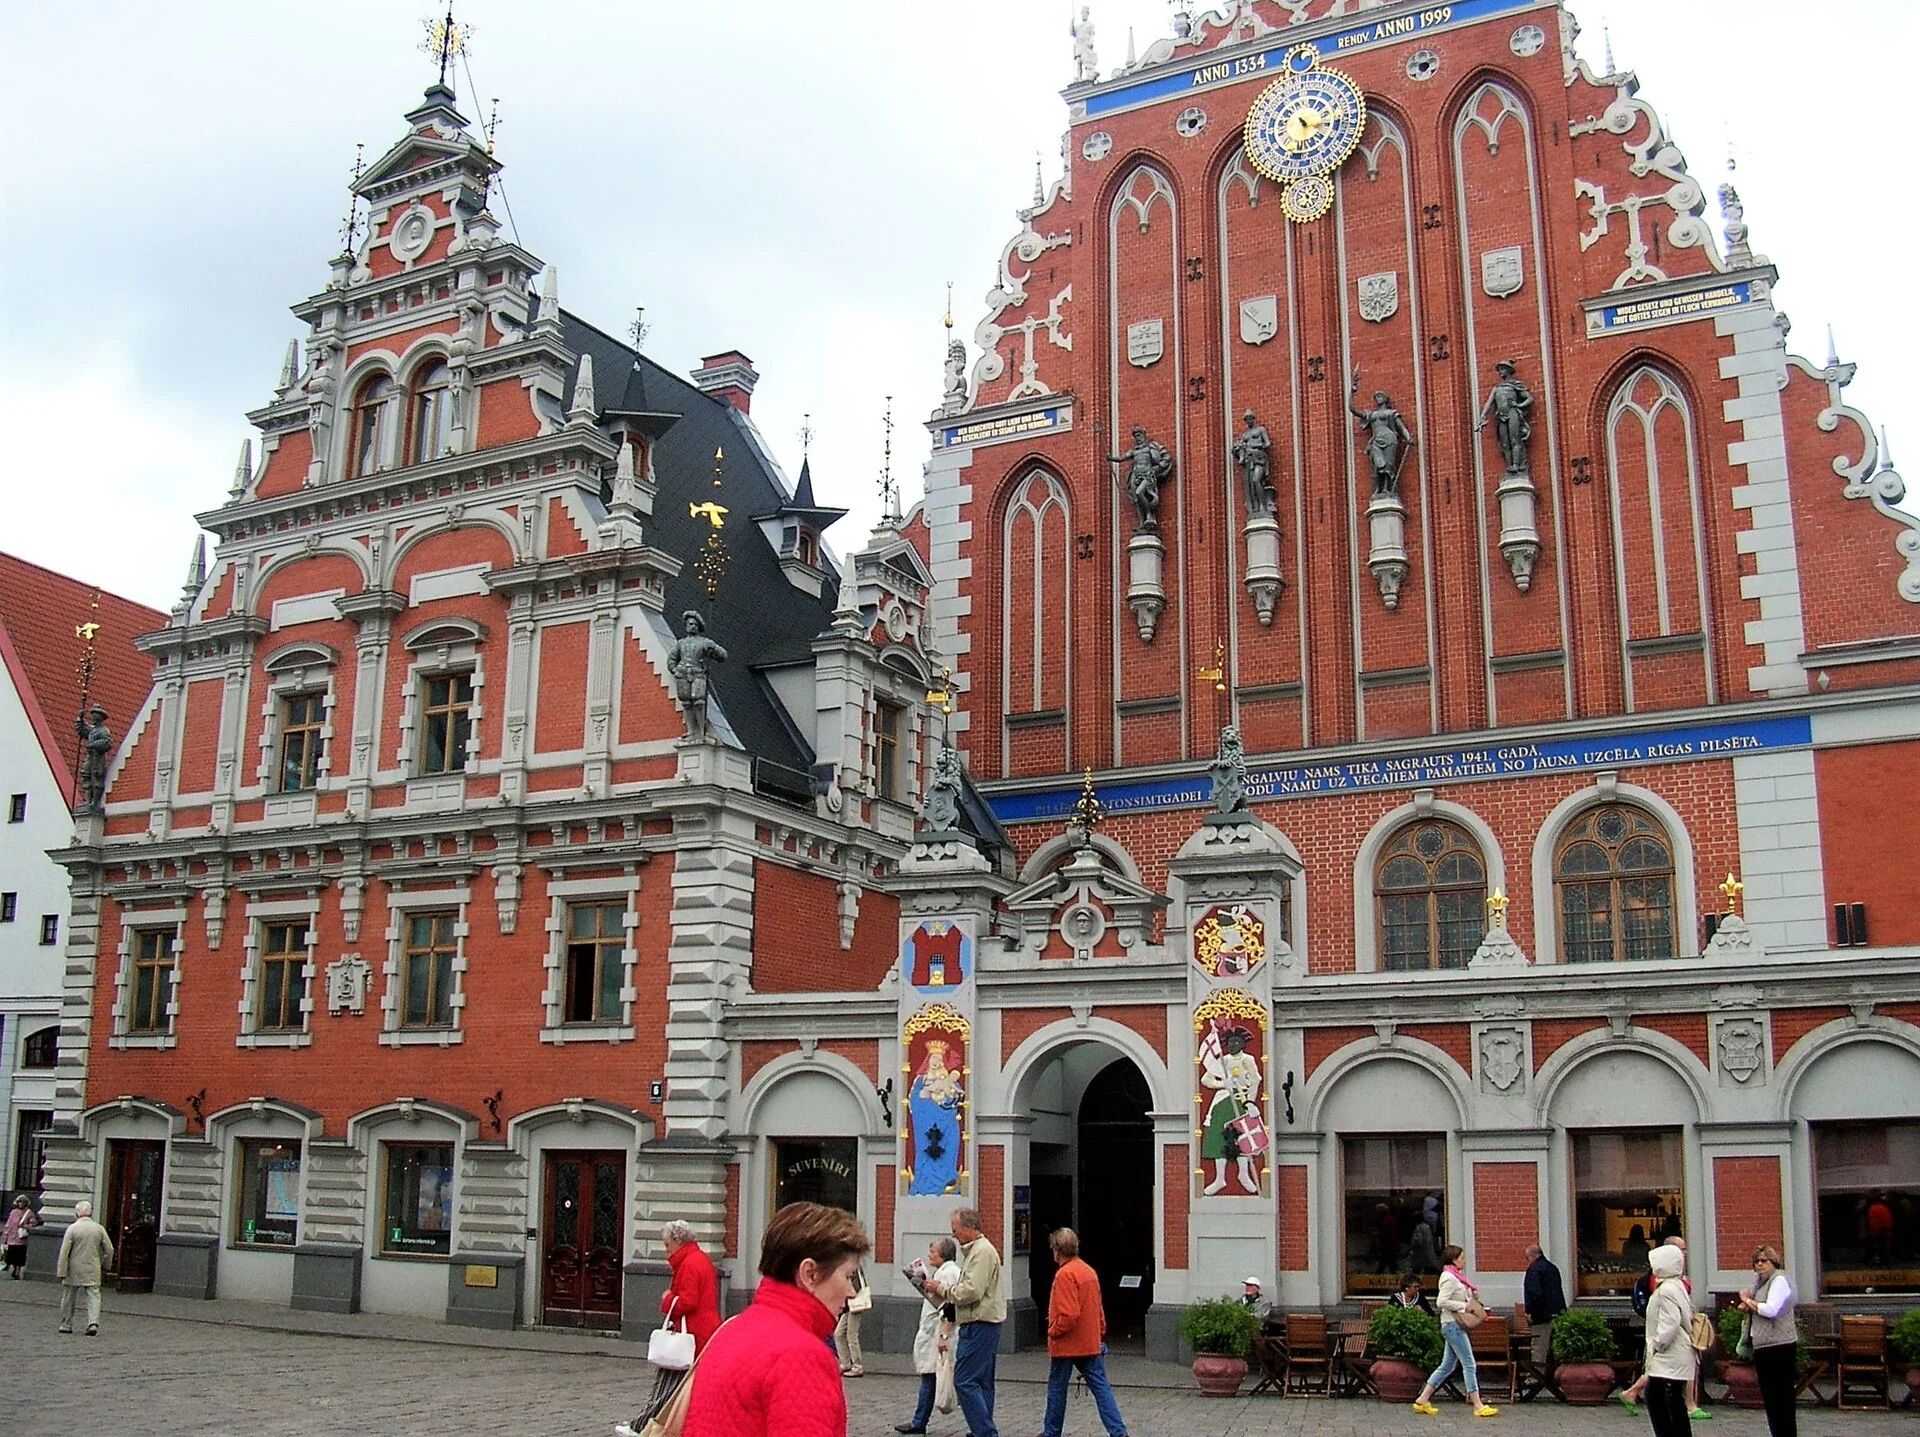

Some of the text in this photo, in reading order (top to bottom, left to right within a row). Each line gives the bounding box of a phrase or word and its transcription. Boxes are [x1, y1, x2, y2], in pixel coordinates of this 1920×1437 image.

[1374, 16, 1415, 40] ANNO
[1420, 6, 1452, 28] 1999
[1192, 53, 1266, 86] ANNO 1334
[1638, 302, 1659, 313] GESETZ
[1660, 299, 1673, 309] UND
[1674, 294, 1704, 307] GEWISSEN
[1651, 308, 1671, 319] SEGEN
[1241, 769, 1298, 786] NGALVJU
[1304, 765, 1340, 779] NAMS
[1346, 761, 1379, 775] TIKA
[1386, 753, 1454, 771] SAGRAUTS
[1461, 750, 1492, 763] 1941.
[1245, 736, 1764, 796] ODU NAMU UZ VECAJIEM PAMATIEM NO JAUNA UZCĒLA RĪGAS PILSĒTA.
[653, 1085, 660, 1096] 6
